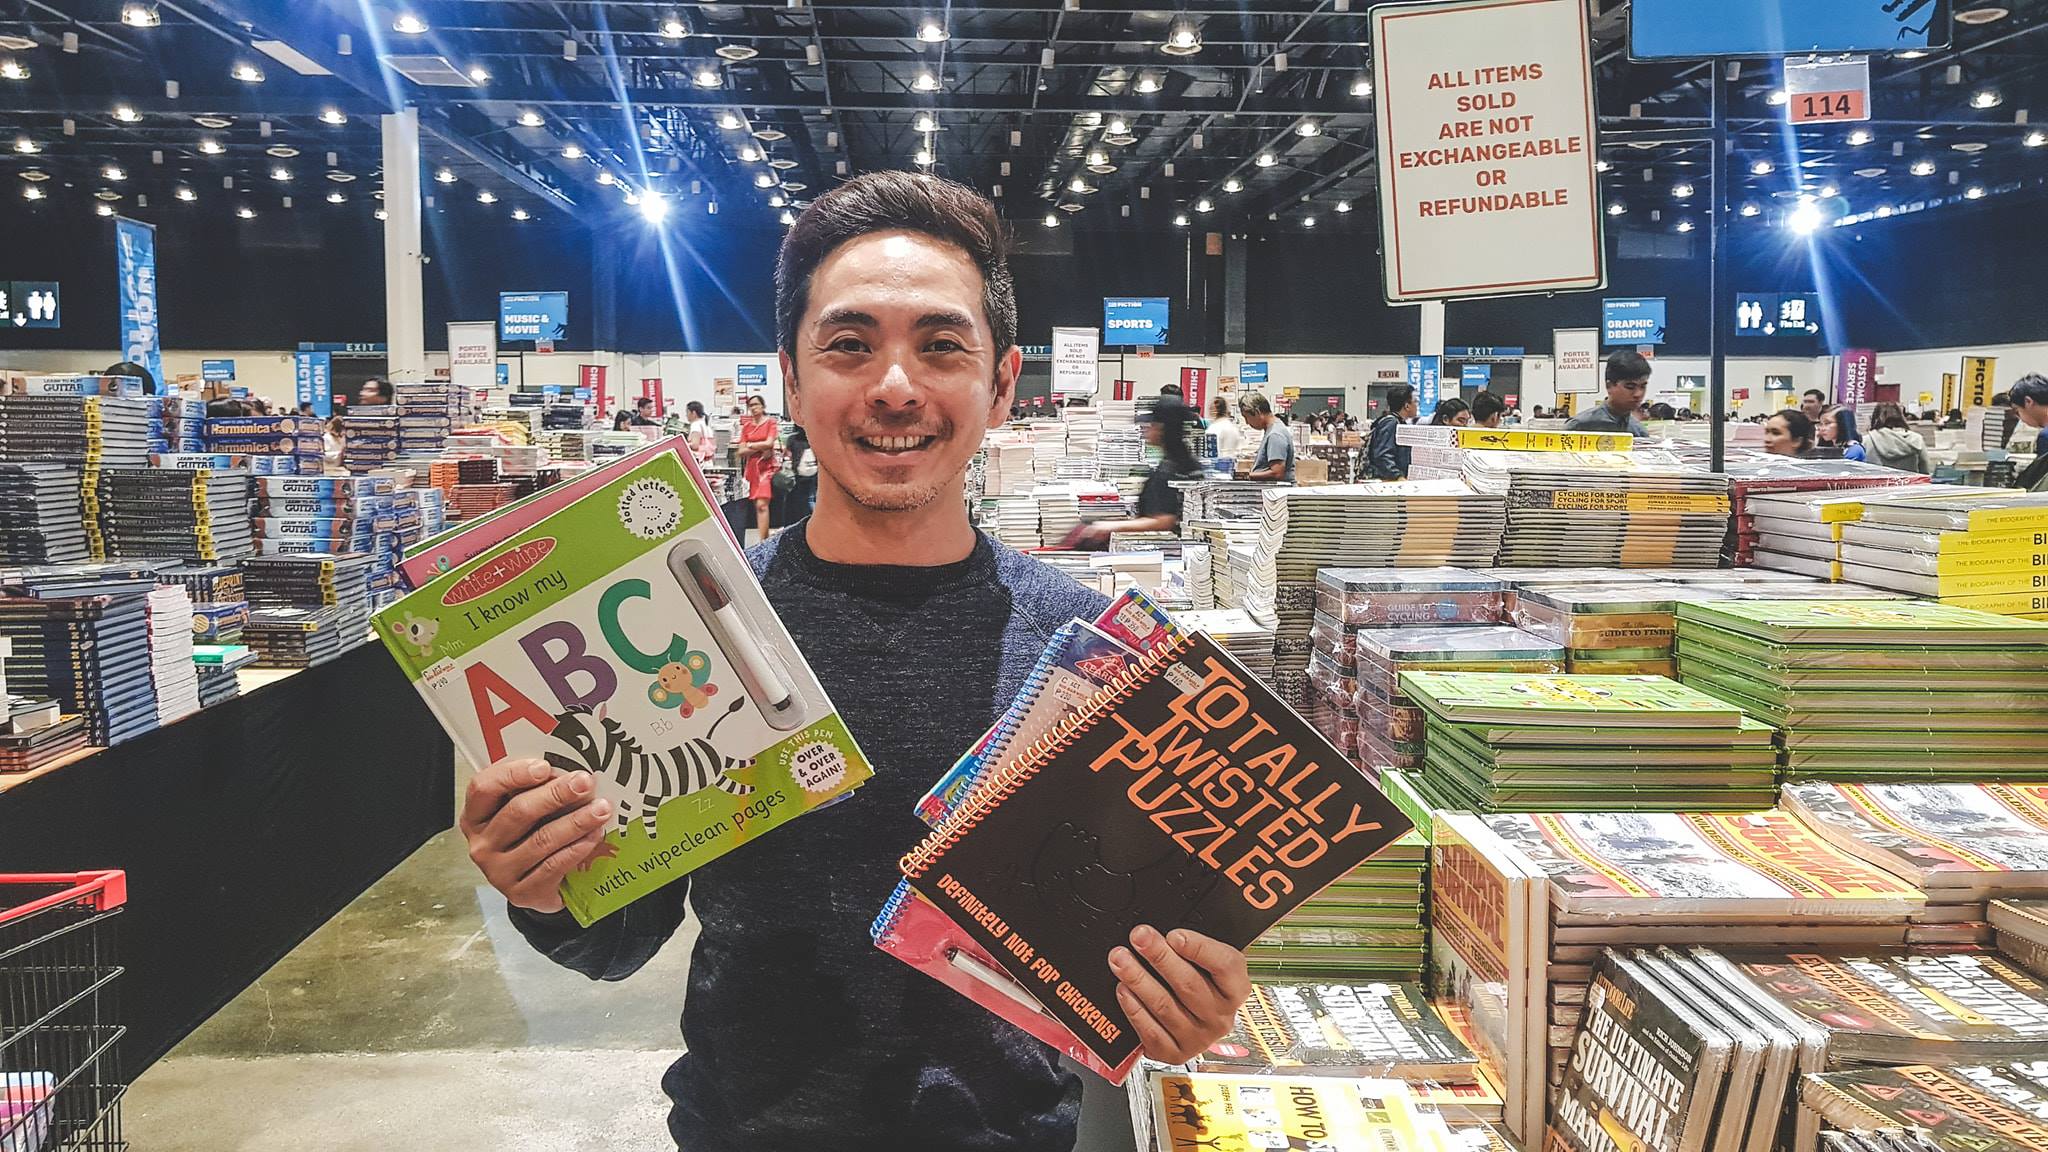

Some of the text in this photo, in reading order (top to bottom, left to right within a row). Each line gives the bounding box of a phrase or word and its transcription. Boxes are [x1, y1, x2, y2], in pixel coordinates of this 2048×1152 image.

[1428, 63, 1543, 90] ALL ITEMS
[1456, 90, 1517, 113] SOLD
[1802, 94, 1852, 119] 114
[1438, 115, 1534, 141] ARE NOT
[1399, 136, 1582, 169] EXCHANGEABLE
[1476, 168, 1508, 188] OR
[1418, 188, 1569, 218] REFUNDABLE
[504, 314, 550, 324] MUSIC &
[1108, 319, 1154, 329] SPORTS
[1607, 319, 1654, 329] GRAPHIC
[505, 325, 540, 335] MOVIE
[1607, 329, 1646, 339] DESIGN
[345, 343, 376, 352] EXIT
[1019, 345, 1046, 354] EXIT
[1467, 347, 1494, 355] EXIT
[43, 383, 83, 392] GUITAR
[299, 354, 312, 403] FICTIO
[1188, 369, 1198, 408] CHILDR
[1845, 362, 1857, 404] SERVICE
[1856, 355, 1868, 404] CUSTOME
[1973, 358, 1986, 406] FICTIO
[211, 424, 270, 435] Harmonica
[211, 443, 270, 453] Harmonica
[282, 484, 320, 493] GUITAR
[637, 481, 675, 500] letters
[1606, 491, 1628, 499] SPORT
[285, 504, 322, 513] GUITAR
[621, 488, 637, 523] dotted
[1604, 503, 1628, 511] SPORT
[280, 525, 318, 534] GUITAR
[643, 512, 677, 535] to trace
[1999, 515, 2035, 523] BIOGRAPHY
[2032, 554, 2048, 566] BI
[2032, 576, 2048, 587] BI
[463, 570, 569, 631] I know my
[1387, 603, 1431, 611] GUIDE TO
[2032, 597, 2048, 609] BI
[1387, 612, 1431, 620] CYCLING
[649, 718, 674, 737] Bb
[778, 729, 834, 766] USE THIS PEN
[797, 744, 825, 763] OVER
[1181, 655, 1383, 844] TOTALLY
[798, 752, 837, 778] & OVER
[806, 763, 843, 788] AGAIN!
[690, 797, 715, 814] Zz
[1089, 713, 1295, 910] PUZZLES
[593, 790, 787, 898] with wipeclean pages
[1691, 815, 1748, 860] WILDERNESS
[1801, 957, 1867, 1004] EXTREME
[1586, 1006, 1685, 1115] THE ULTIMATE
[1668, 1037, 1693, 1064] JOHNSON
[1572, 1030, 1671, 1152] SURVIVAL
[1912, 1070, 2022, 1125] EXTREME
[1289, 1086, 1328, 1139] HOW TO
